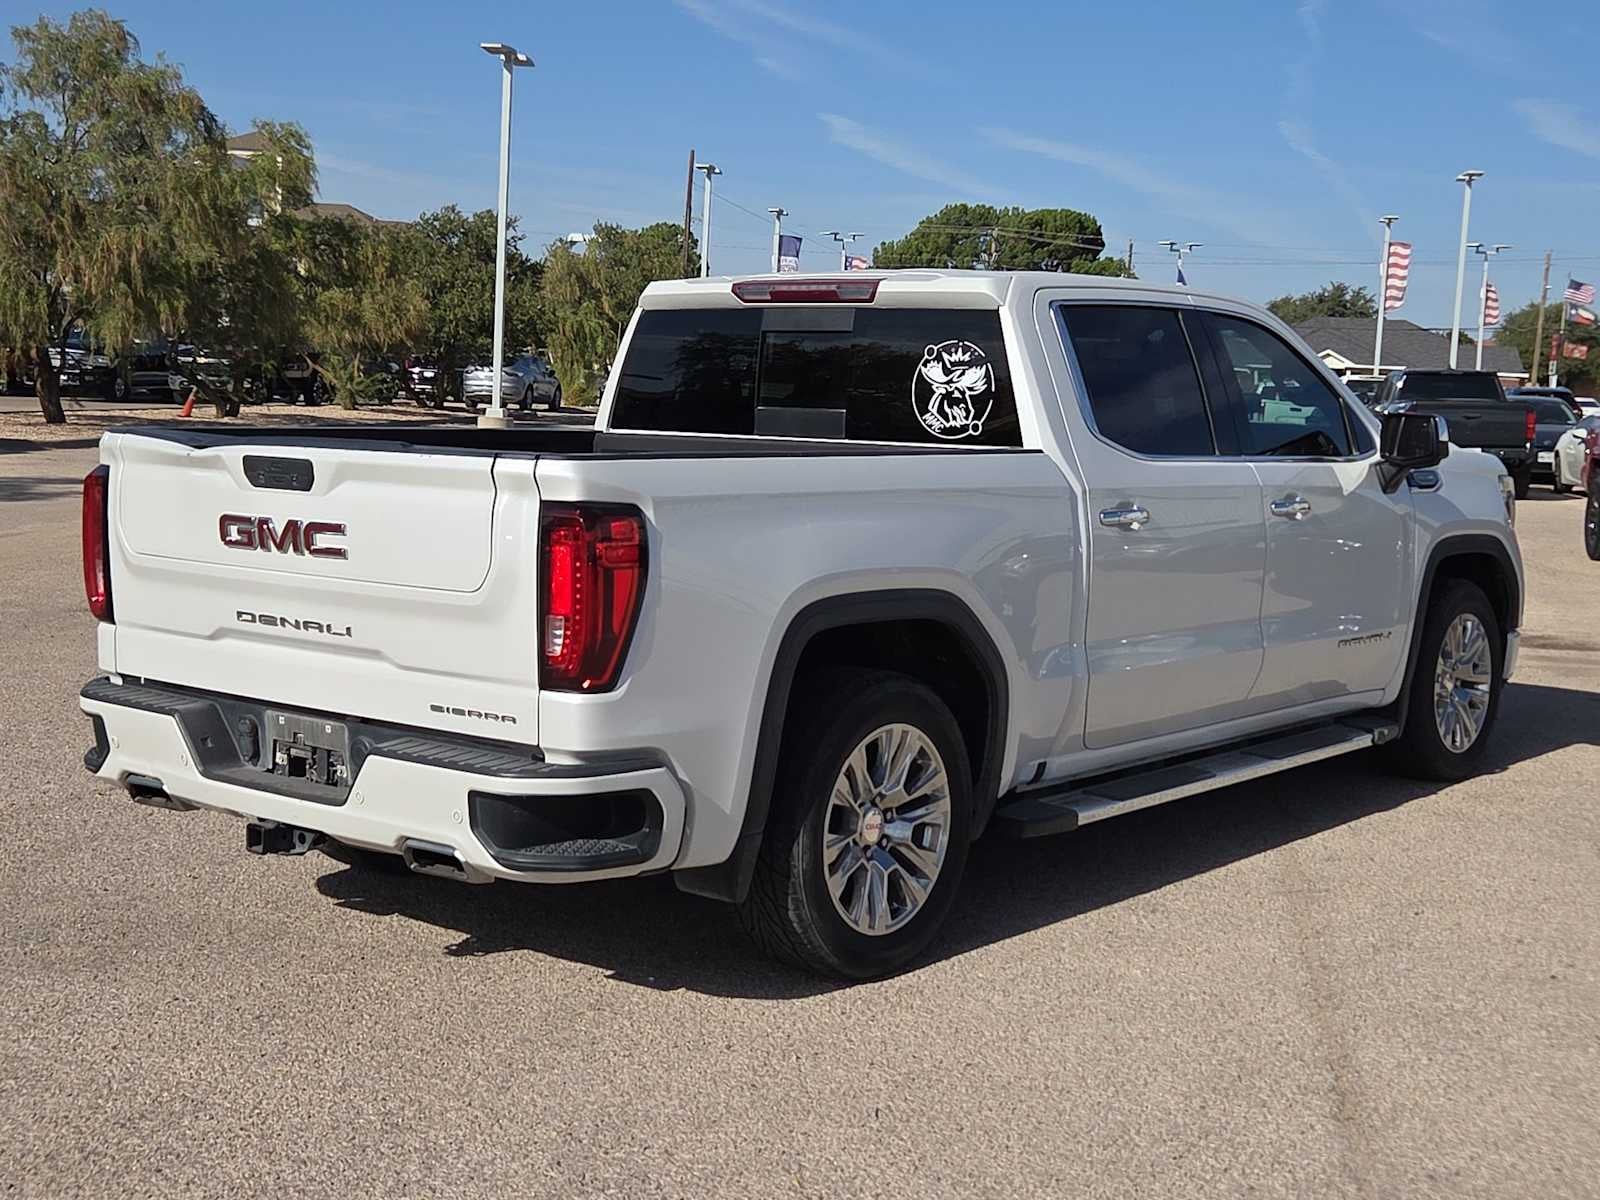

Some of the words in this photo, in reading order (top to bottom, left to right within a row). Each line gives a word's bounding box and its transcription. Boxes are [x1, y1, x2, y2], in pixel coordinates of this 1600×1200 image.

[922, 412, 945, 433] MMC
[219, 513, 349, 561] GMC
[236, 609, 353, 638] DENALI
[429, 703, 518, 725] SIERRA
